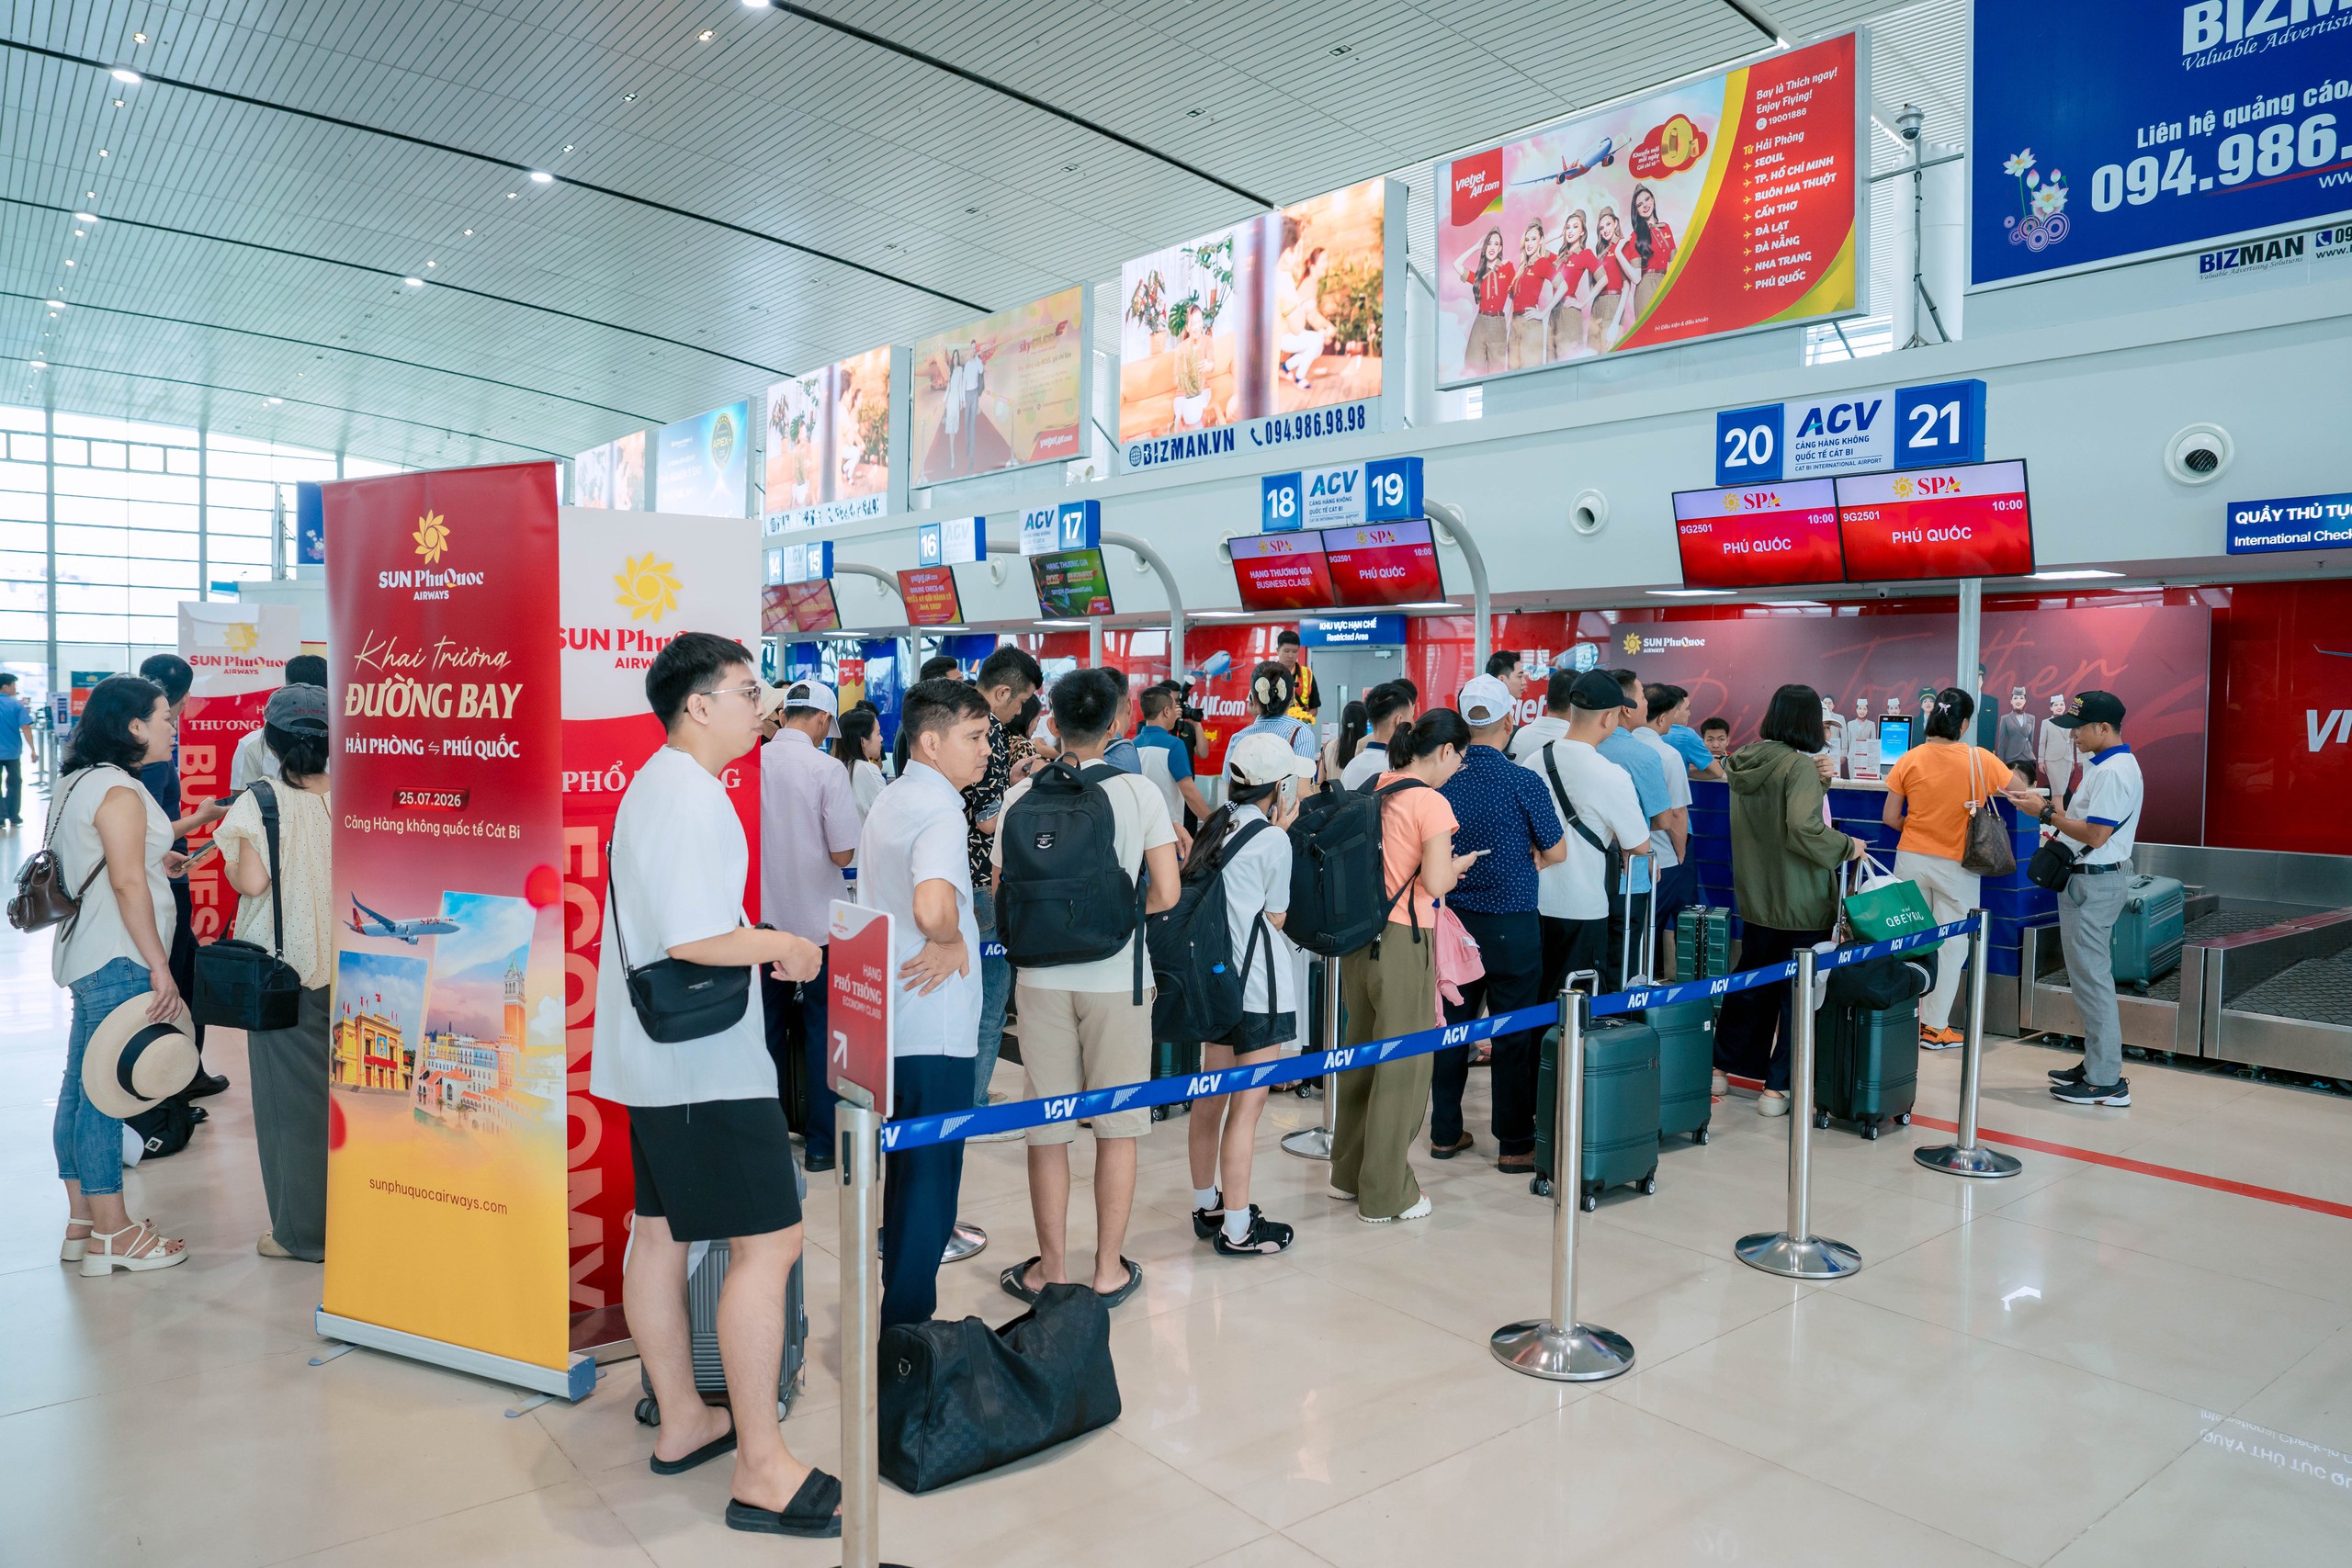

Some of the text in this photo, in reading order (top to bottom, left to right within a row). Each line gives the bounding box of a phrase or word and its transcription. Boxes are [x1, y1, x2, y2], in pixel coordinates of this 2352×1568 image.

[2182, 38, 2257, 72] Valuable
[1756, 66, 1838, 100] Bay là Thích ngay!
[1756, 89, 1813, 115] Enjoy Flying!
[1769, 107, 1807, 125] 19001886
[2137, 95, 2295, 149] Liên hệ quảng
[1743, 131, 1804, 155] Từ Hải Phòng
[1754, 152, 1785, 168] SEOUL
[1754, 155, 1835, 185] TP. CHÍ MINH
[1754, 172, 1838, 202] BUÔN MA THUỘT
[1776, 200, 1799, 214] THƠ
[1755, 220, 1790, 237] ĐÀ LẠT
[1755, 234, 1800, 254] ĐÀ NẴNG
[1755, 251, 1812, 272] NHA TRANG
[2199, 235, 2304, 275] BIZMAN
[1755, 268, 1806, 289] PHÚ QUỐC
[2199, 256, 2303, 280] Valuable Advertising Solutions
[1796, 399, 1883, 438] ACV
[1908, 400, 1961, 448] 21
[1143, 404, 1365, 466] BIZMAN.VN 094.986.98.98
[1795, 434, 1870, 450] CẢNG HÀNG KHÔNG
[1724, 424, 1774, 468] 20
[1795, 450, 1815, 462] QUỐC
[1817, 448, 1827, 458] TẾ
[1828, 447, 1843, 457] CÁT
[1813, 460, 1856, 469] INTERNATIONAL
[1857, 457, 1882, 466] AIRPORT
[1309, 469, 1359, 498] ACV
[1372, 472, 1404, 507] 19
[1917, 474, 1962, 496] SPA
[1267, 486, 1296, 519] 18
[1744, 491, 1782, 510] SPA
[1992, 499, 2023, 512] 10:00
[1024, 510, 1055, 531] ACV
[1807, 513, 1834, 525] 10:00
[1842, 510, 1881, 522] 9G2501
[2235, 502, 2323, 525] QUẦY THỦ
[1062, 511, 1082, 540] 17
[1680, 523, 1713, 535] 9G2501
[1892, 524, 1973, 545] PHÚ QUỐC
[921, 533, 937, 558] 16
[1270, 539, 1293, 553] SPA
[1370, 530, 1396, 545] SPA
[1723, 536, 1792, 555] PHÚ QUỐC
[2234, 531, 2311, 547] International
[808, 550, 820, 571] 15
[1414, 547, 1431, 557] 10:00
[768, 557, 781, 577] 14
[1250, 570, 1270, 581] HẠNG
[1300, 566, 1313, 575] GIA
[1359, 566, 1406, 580] PHÚ QUỐC
[379, 568, 484, 590] SUN PhuQuoc
[1256, 578, 1310, 590] BUSINESS CLASS
[413, 590, 450, 601] AIRWAYS
[1319, 621, 1337, 631] KHU
[1349, 619, 1362, 631] HẠN
[1363, 616, 1377, 629] CHẾ
[1327, 632, 1369, 642] Restricted Area
[1643, 637, 1706, 648] SUN PhuQuoc
[189, 655, 221, 666] SUN
[354, 629, 426, 674] Khai
[345, 673, 524, 719] ĐƯỜNG BAY
[188, 719, 263, 731] THƯƠNG
[345, 733, 520, 760] HẢI PHÒNG PHÚ QUỐC
[561, 760, 627, 793] PHỔ
[399, 791, 462, 807] 25.07.2026
[345, 815, 520, 840] Cảng Hàng không quốc tế Cát Bi
[1938, 925, 1951, 937] ACV
[1890, 937, 1904, 952] ACV
[1838, 949, 1852, 964] ACV
[863, 964, 882, 982] HẠNG
[833, 972, 882, 1006] PHỔ THÔNG
[1710, 977, 1730, 994] ACV
[842, 995, 882, 1020] ECONOMY CLASS
[1627, 991, 1650, 1009] ACV
[1442, 1025, 1470, 1046] ACV
[1323, 1048, 1355, 1070] ACV
[1186, 1073, 1223, 1097] ACV
[368, 1177, 509, 1216] sunphuquocairways.com
